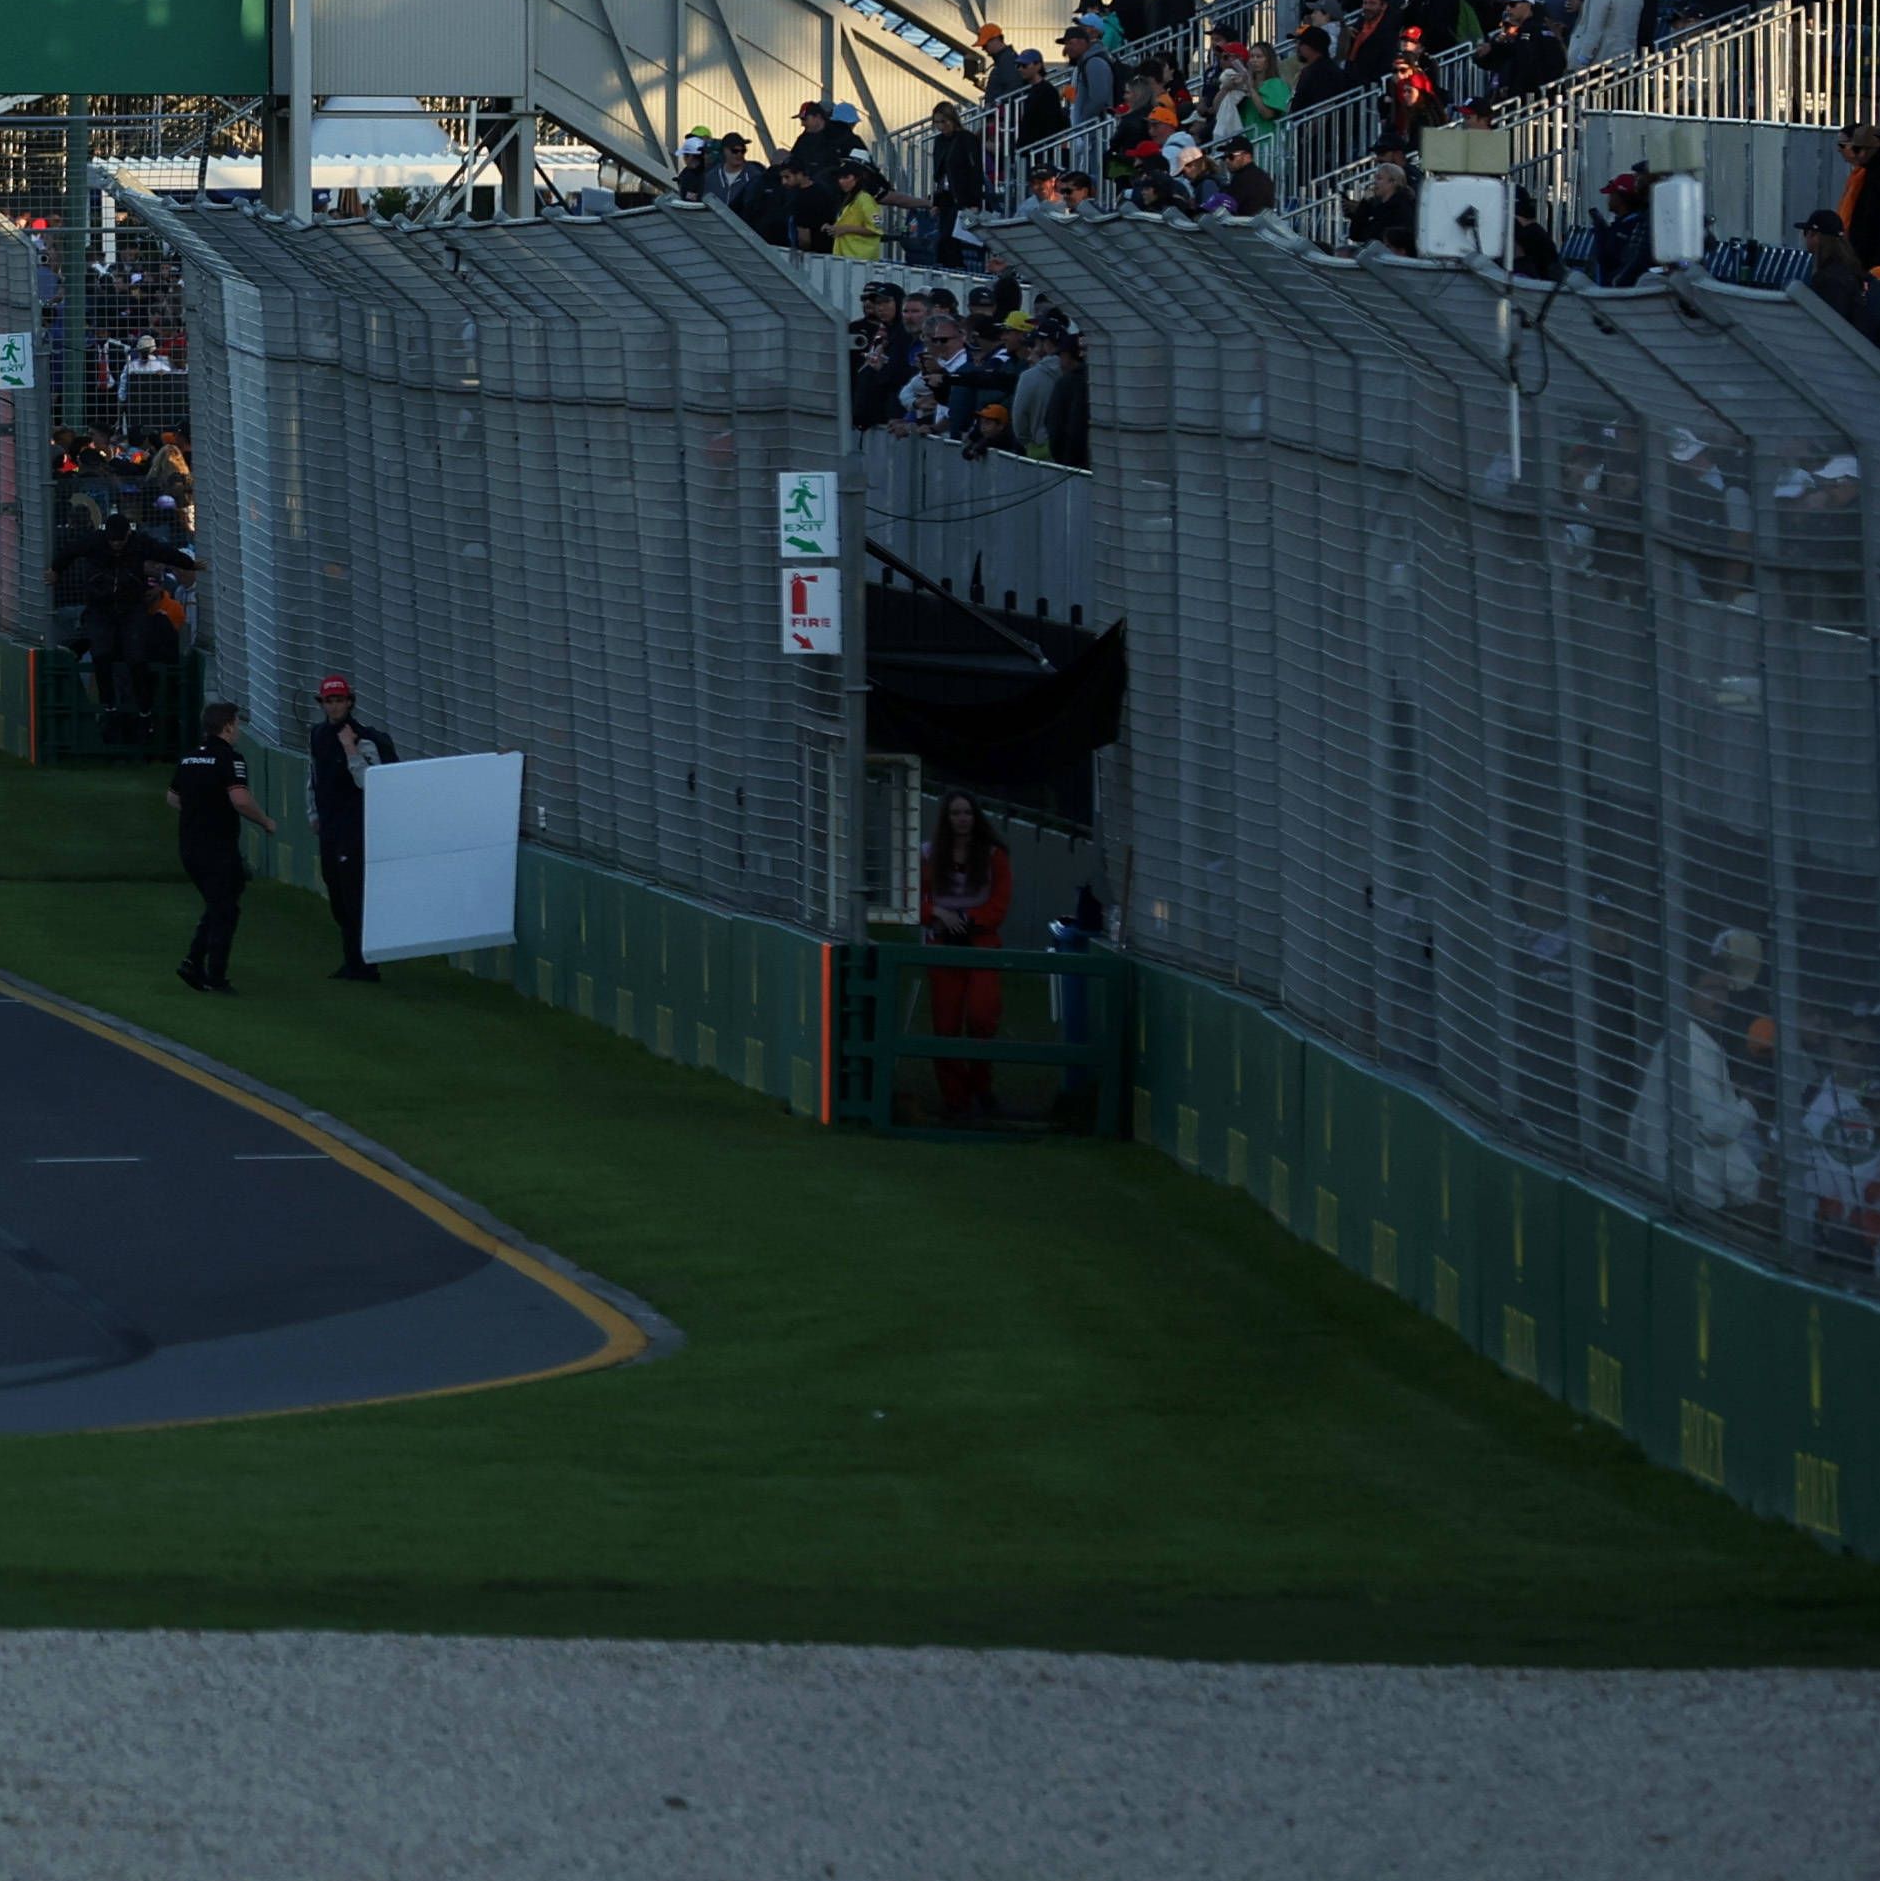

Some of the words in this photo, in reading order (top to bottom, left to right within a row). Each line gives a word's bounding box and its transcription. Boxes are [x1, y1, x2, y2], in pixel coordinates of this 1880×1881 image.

[0, 365, 24, 373] EXIT
[784, 523, 824, 532] EXIT
[791, 617, 832, 628] FIRE
